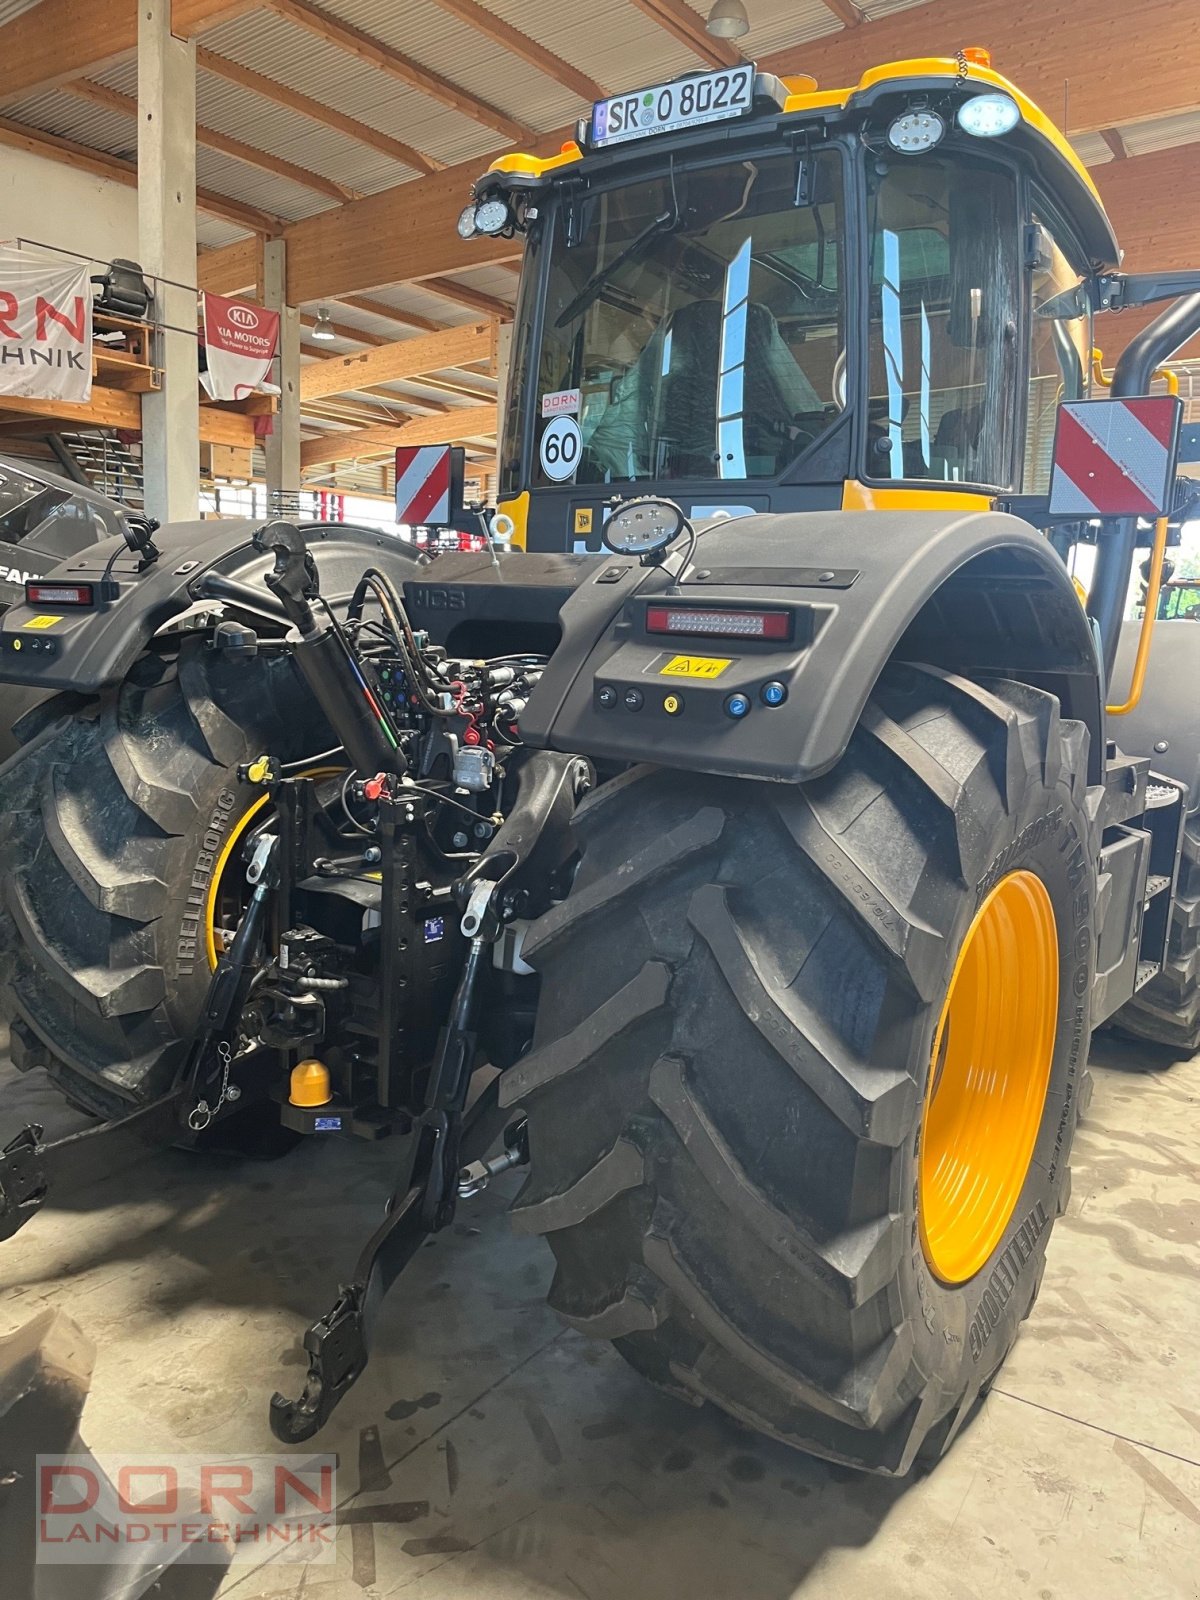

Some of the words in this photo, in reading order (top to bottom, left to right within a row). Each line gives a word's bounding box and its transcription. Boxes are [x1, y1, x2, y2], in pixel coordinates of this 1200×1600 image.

[608, 98, 639, 134] SR
[679, 71, 748, 116] 8022
[648, 125, 666, 135] DORN
[233, 309, 254, 326] KIA
[216, 325, 232, 339] KIA
[234, 331, 271, 347] MOTORS
[221, 338, 229, 346] The
[229, 341, 243, 350] Power
[544, 394, 577, 408] DORN
[544, 432, 577, 465] 60
[0, 565, 45, 586] FAH
[174, 786, 238, 979] TRELLEBORG
[1048, 1082, 1073, 1184] POWER
[969, 1198, 1049, 1364] TRELLEBORG
